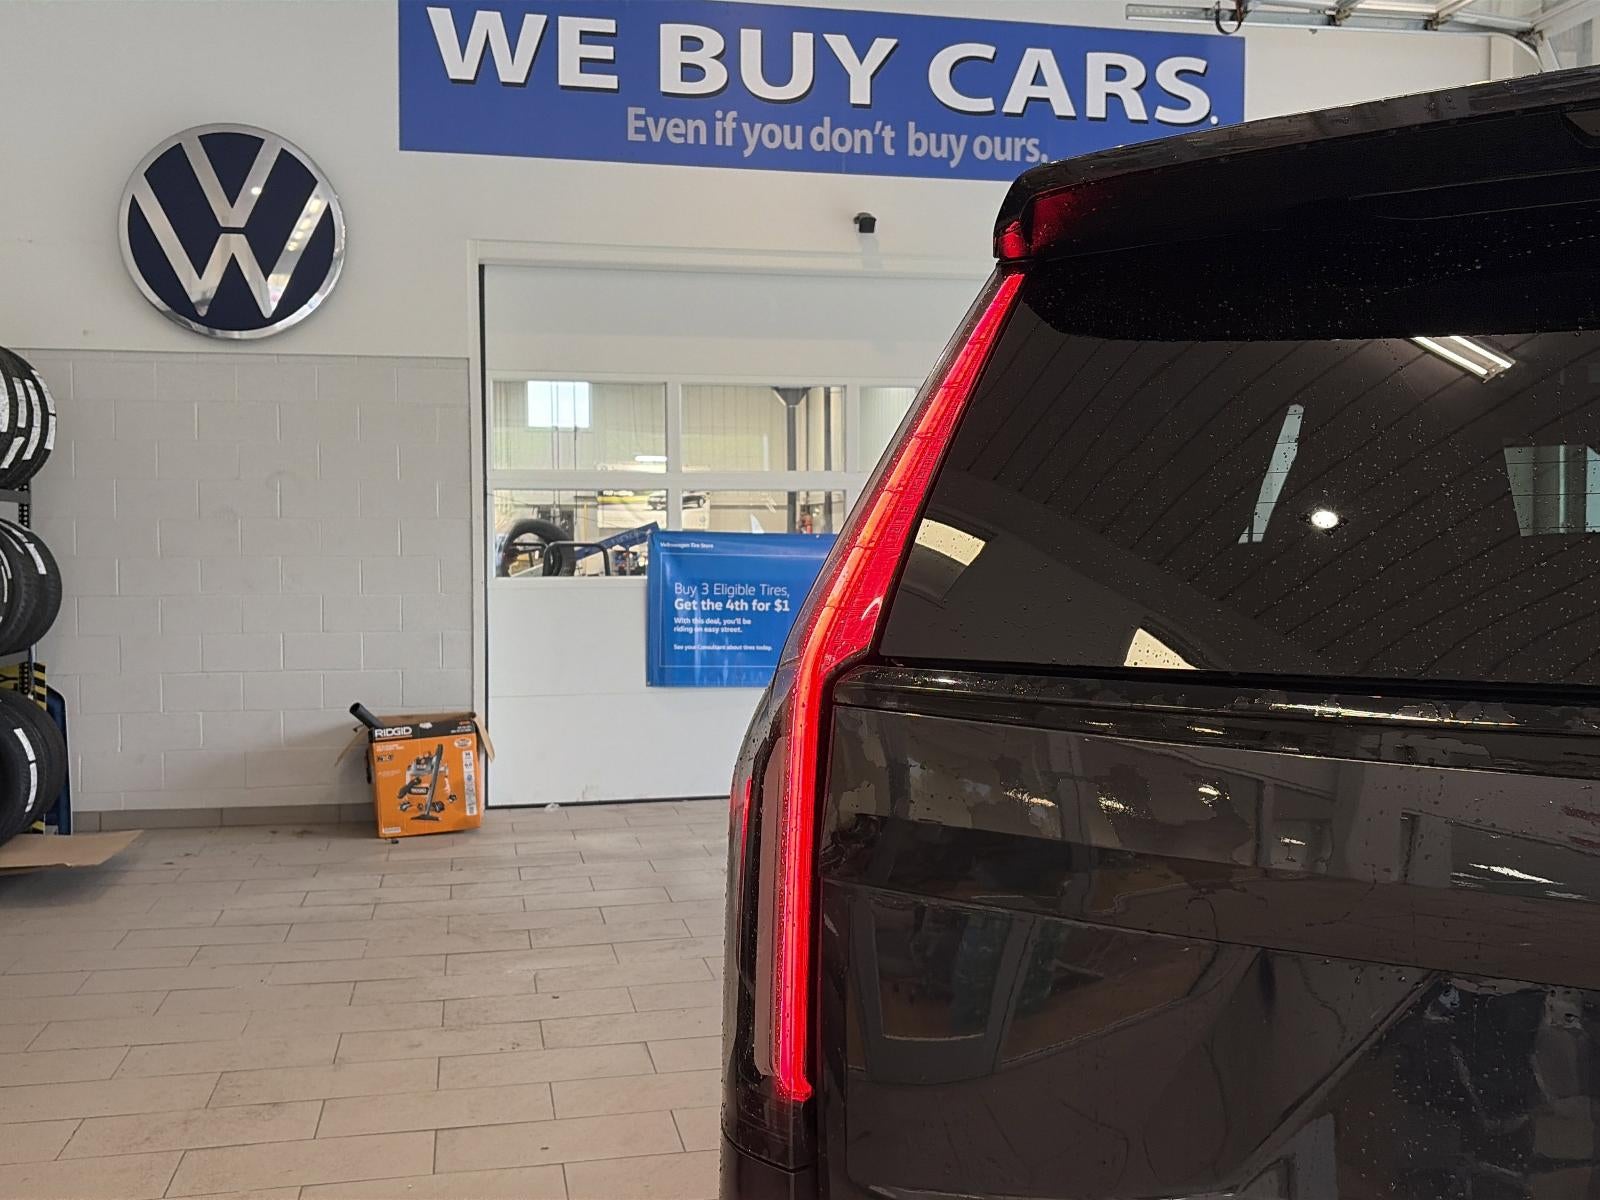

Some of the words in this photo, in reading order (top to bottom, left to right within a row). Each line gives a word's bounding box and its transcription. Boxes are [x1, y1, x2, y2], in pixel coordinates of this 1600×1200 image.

[427, 7, 619, 90] WE
[660, 23, 899, 106] BUY
[928, 42, 1219, 126] CARS.
[627, 106, 708, 145] Even
[714, 109, 739, 147] if
[741, 121, 803, 158] you
[809, 116, 896, 156] don't
[908, 132, 967, 169] buy
[972, 136, 1049, 164] ours.
[674, 582, 697, 597] Buy
[702, 583, 709, 595] 3
[714, 583, 755, 598] Eligible
[760, 584, 790, 597] Tires,
[674, 598, 698, 611] Get
[701, 599, 723, 611] the
[726, 599, 749, 611] 4th
[752, 599, 771, 612] for
[774, 599, 790, 613] $1
[705, 617, 722, 626] deal,
[673, 626, 693, 634] riding
[374, 726, 413, 737] RIDGID
